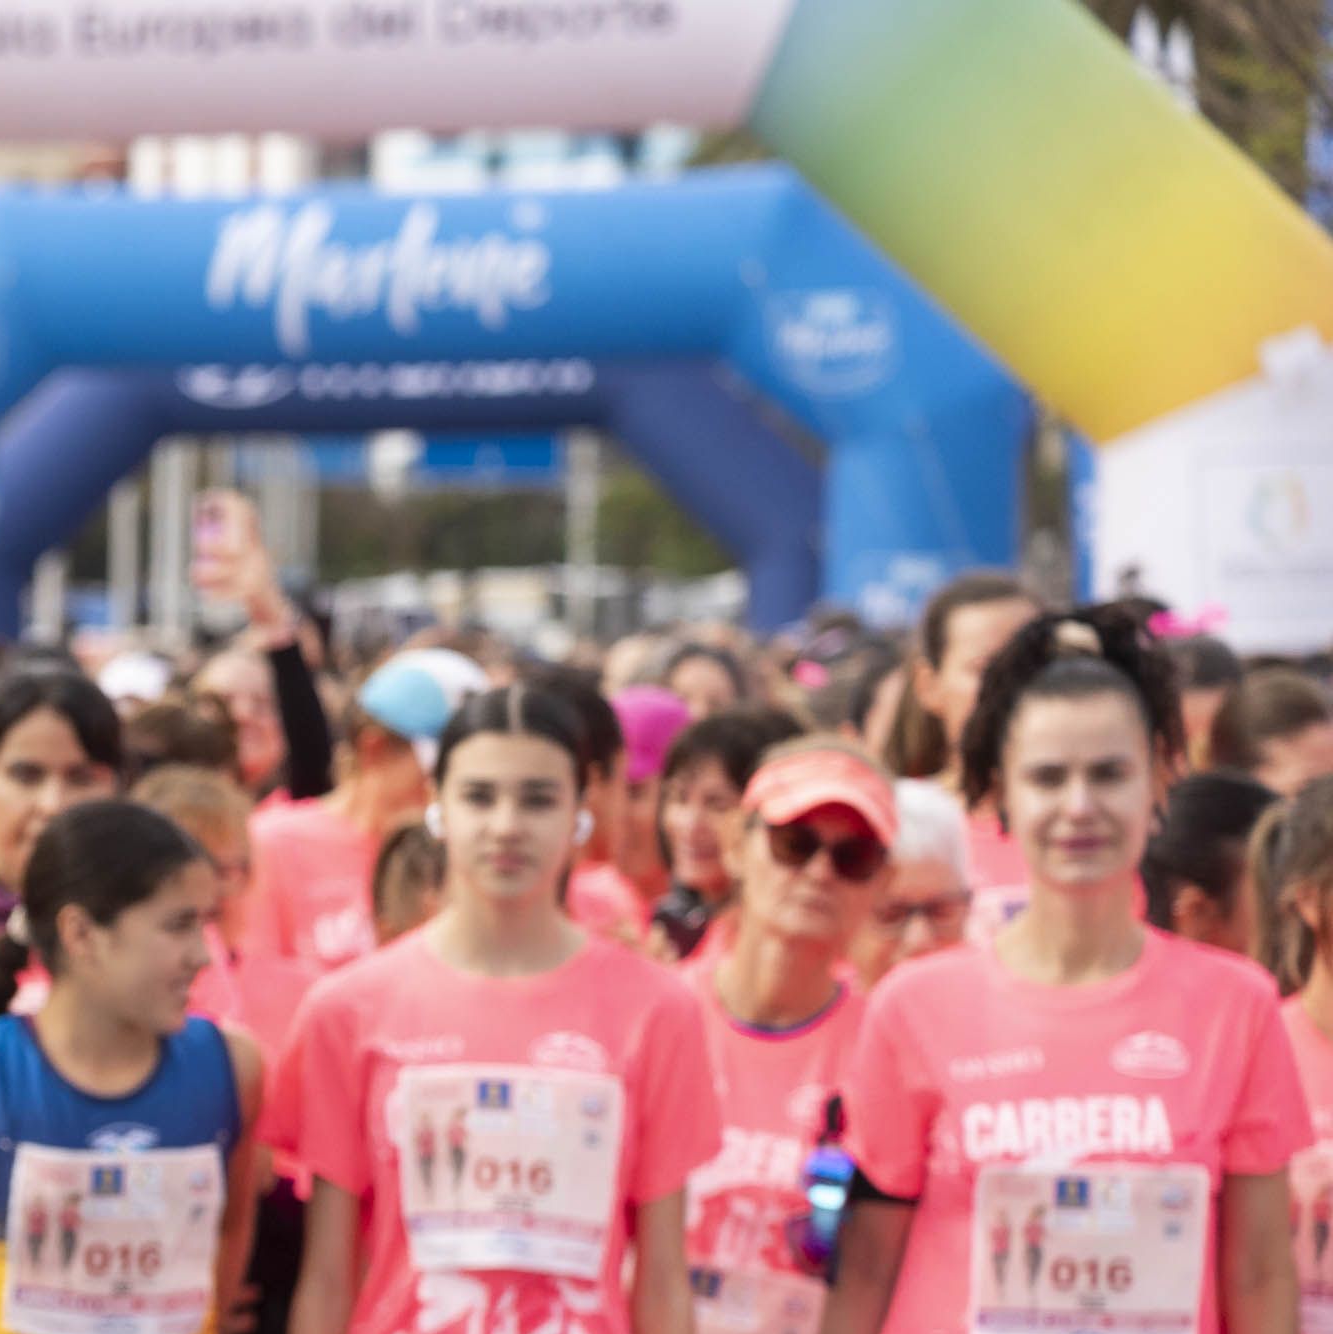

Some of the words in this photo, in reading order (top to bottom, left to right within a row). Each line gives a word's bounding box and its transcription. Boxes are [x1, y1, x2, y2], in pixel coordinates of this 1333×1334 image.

[962, 1093, 1175, 1161] CARRERA
[473, 1155, 554, 1195] 016
[84, 1241, 162, 1278] 016
[1050, 1257, 1133, 1292] 016
